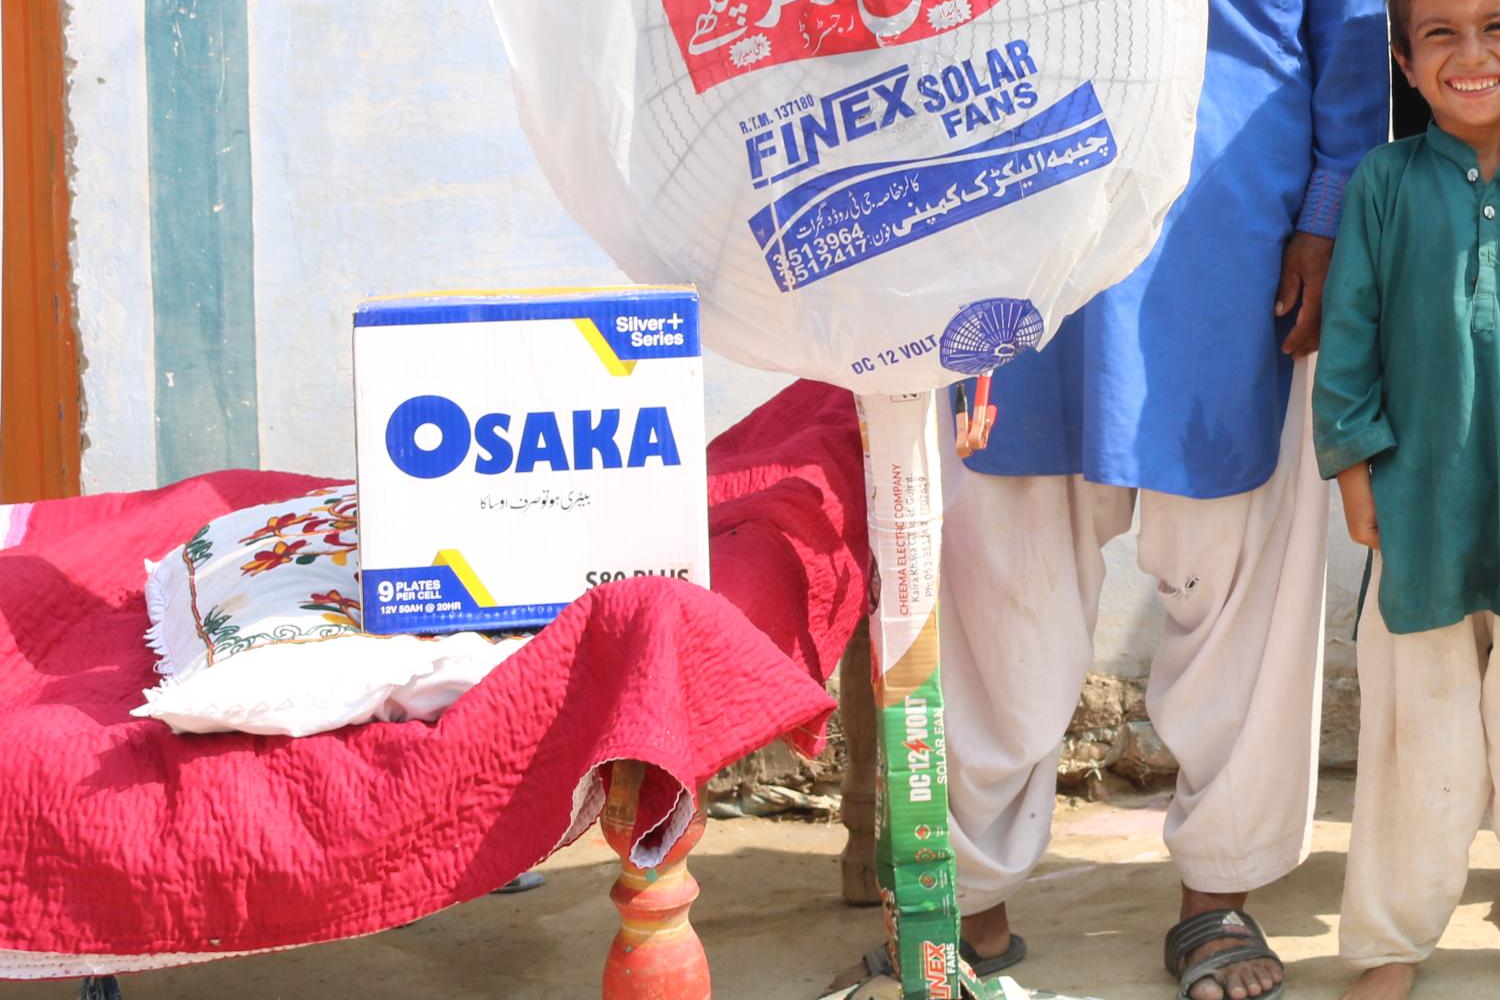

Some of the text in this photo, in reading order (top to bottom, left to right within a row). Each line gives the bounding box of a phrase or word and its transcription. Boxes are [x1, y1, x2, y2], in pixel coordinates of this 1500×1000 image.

[745, 39, 1038, 190] FINEX SOLAR
[774, 93, 815, 120] 137180
[940, 83, 1038, 139] FANS
[773, 222, 864, 271] 3513964
[631, 331, 684, 347] Series
[851, 334, 938, 376] DC 12 VOLT
[892, 464, 904, 519] COMPANY
[378, 580, 441, 602] 9 PLATES
[381, 605, 397, 614] 12V
[396, 590, 442, 601] PER CELL
[898, 567, 909, 616] CHEEMA
[905, 695, 931, 802] DC 12 VOLT
[935, 738, 947, 785] SOLAR
[924, 940, 951, 1000] INEX
[946, 942, 956, 974] FANS
